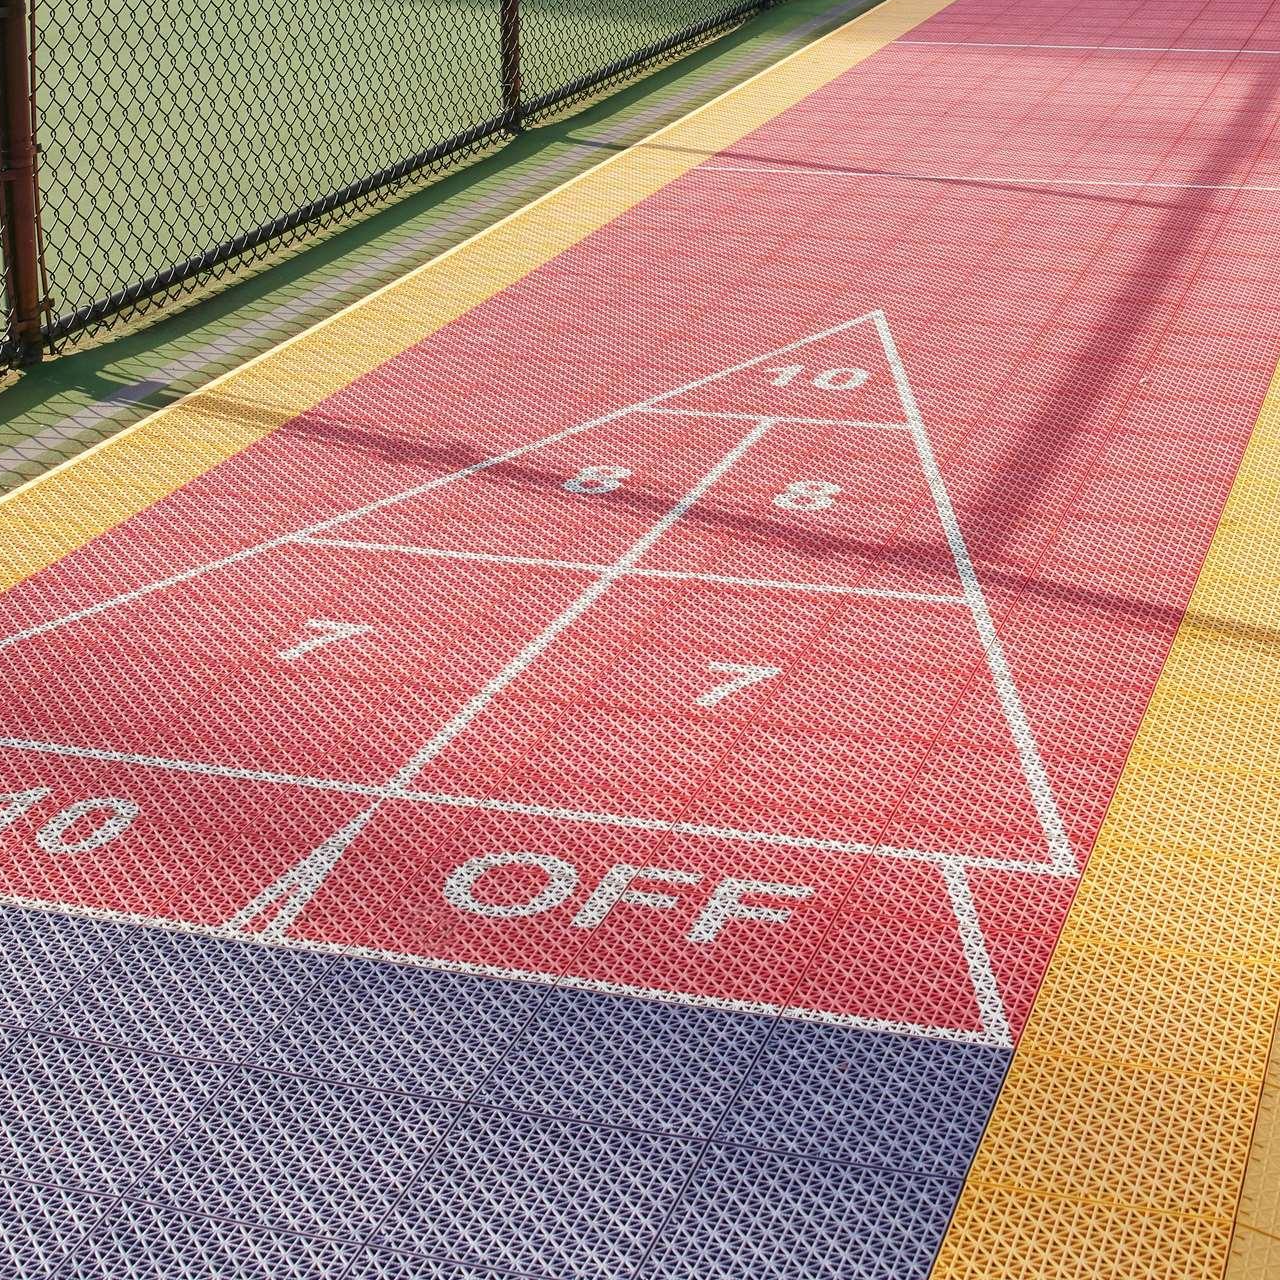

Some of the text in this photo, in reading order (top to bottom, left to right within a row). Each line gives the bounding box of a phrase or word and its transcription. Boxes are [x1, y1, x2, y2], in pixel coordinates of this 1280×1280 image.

[762, 363, 870, 390] 10
[561, 465, 632, 494] 8
[772, 480, 842, 510] 8
[279, 621, 372, 660] 7
[696, 662, 782, 707] 7
[442, 850, 814, 944] OFF
